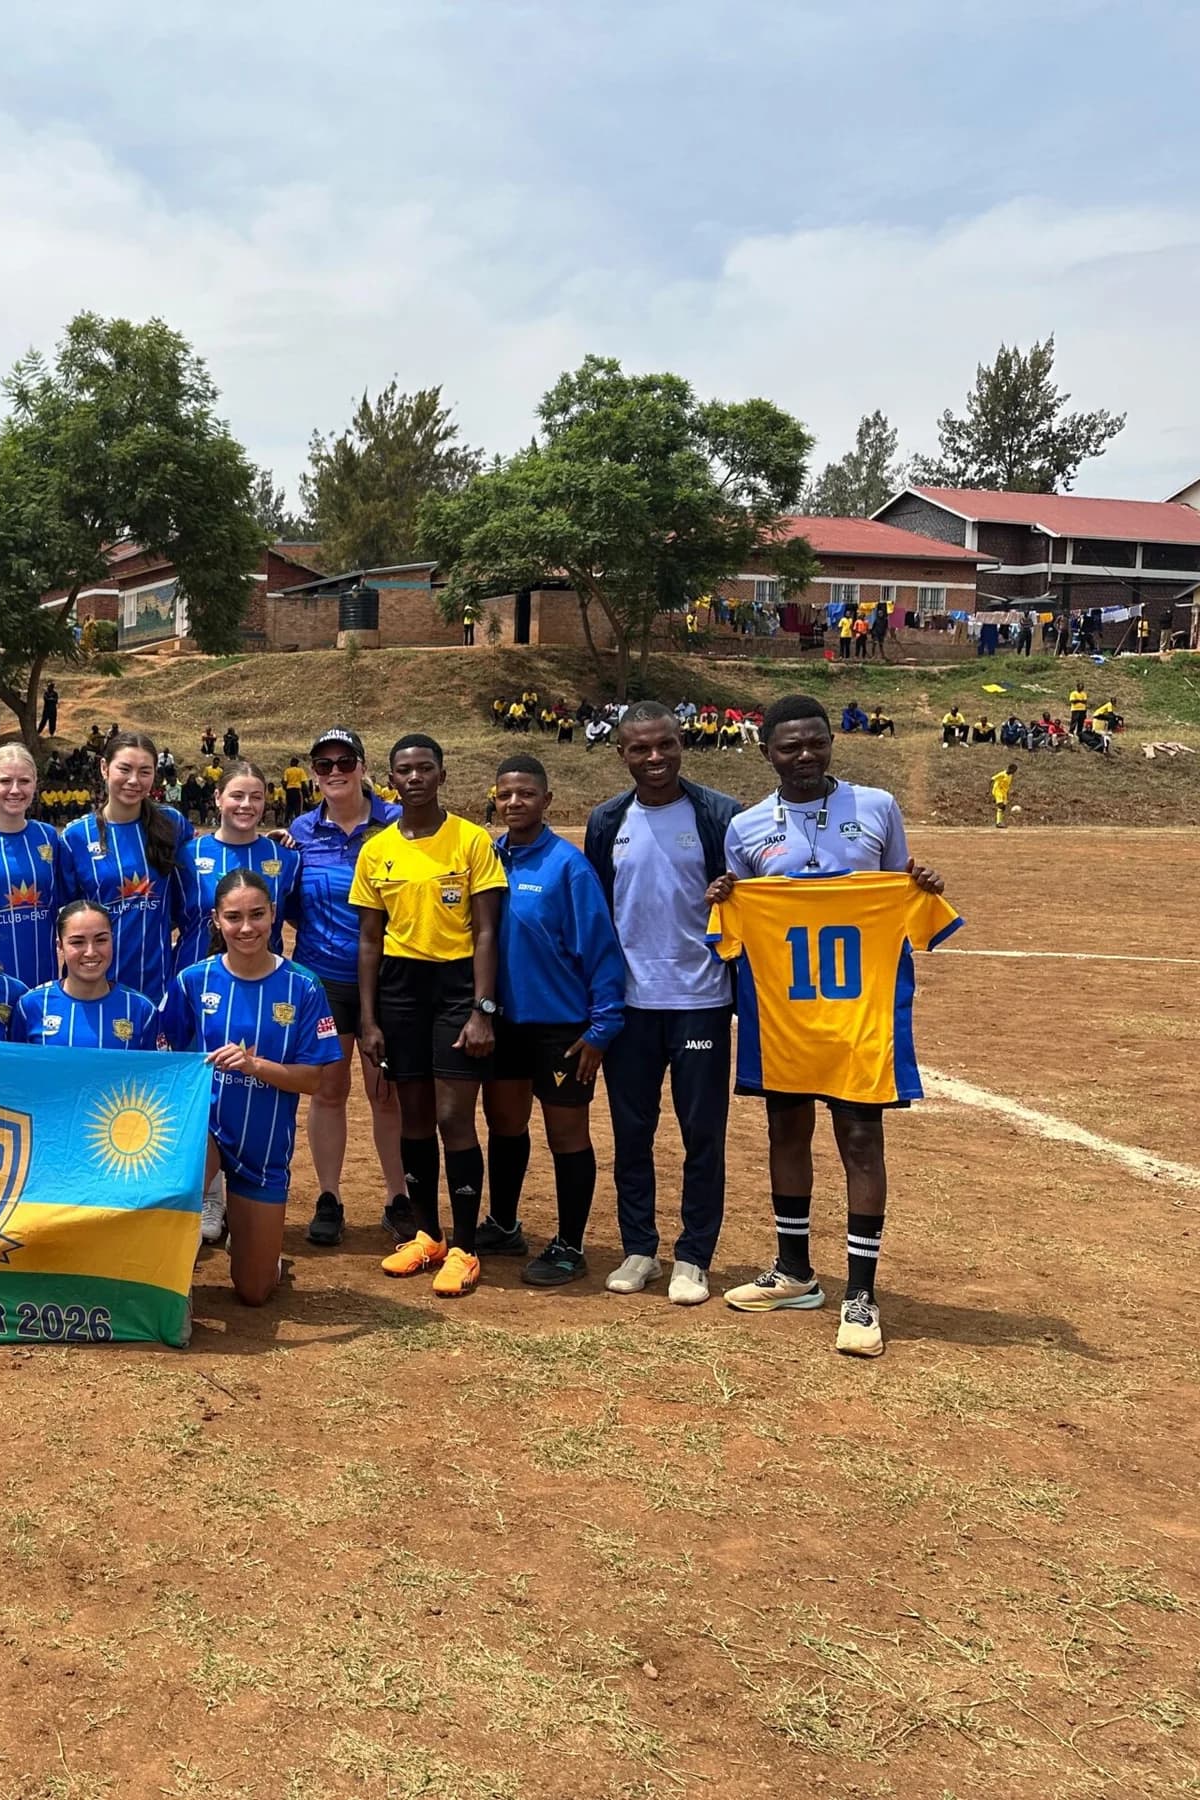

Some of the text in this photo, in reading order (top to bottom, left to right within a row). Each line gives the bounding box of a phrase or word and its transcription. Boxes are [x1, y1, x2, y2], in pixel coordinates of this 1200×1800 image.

[763, 834, 786, 846] JAKO
[30, 909, 49, 921] EAST
[784, 924, 863, 1001] 10
[684, 1039, 714, 1050] JAKO
[16, 1301, 114, 1342] 2026
